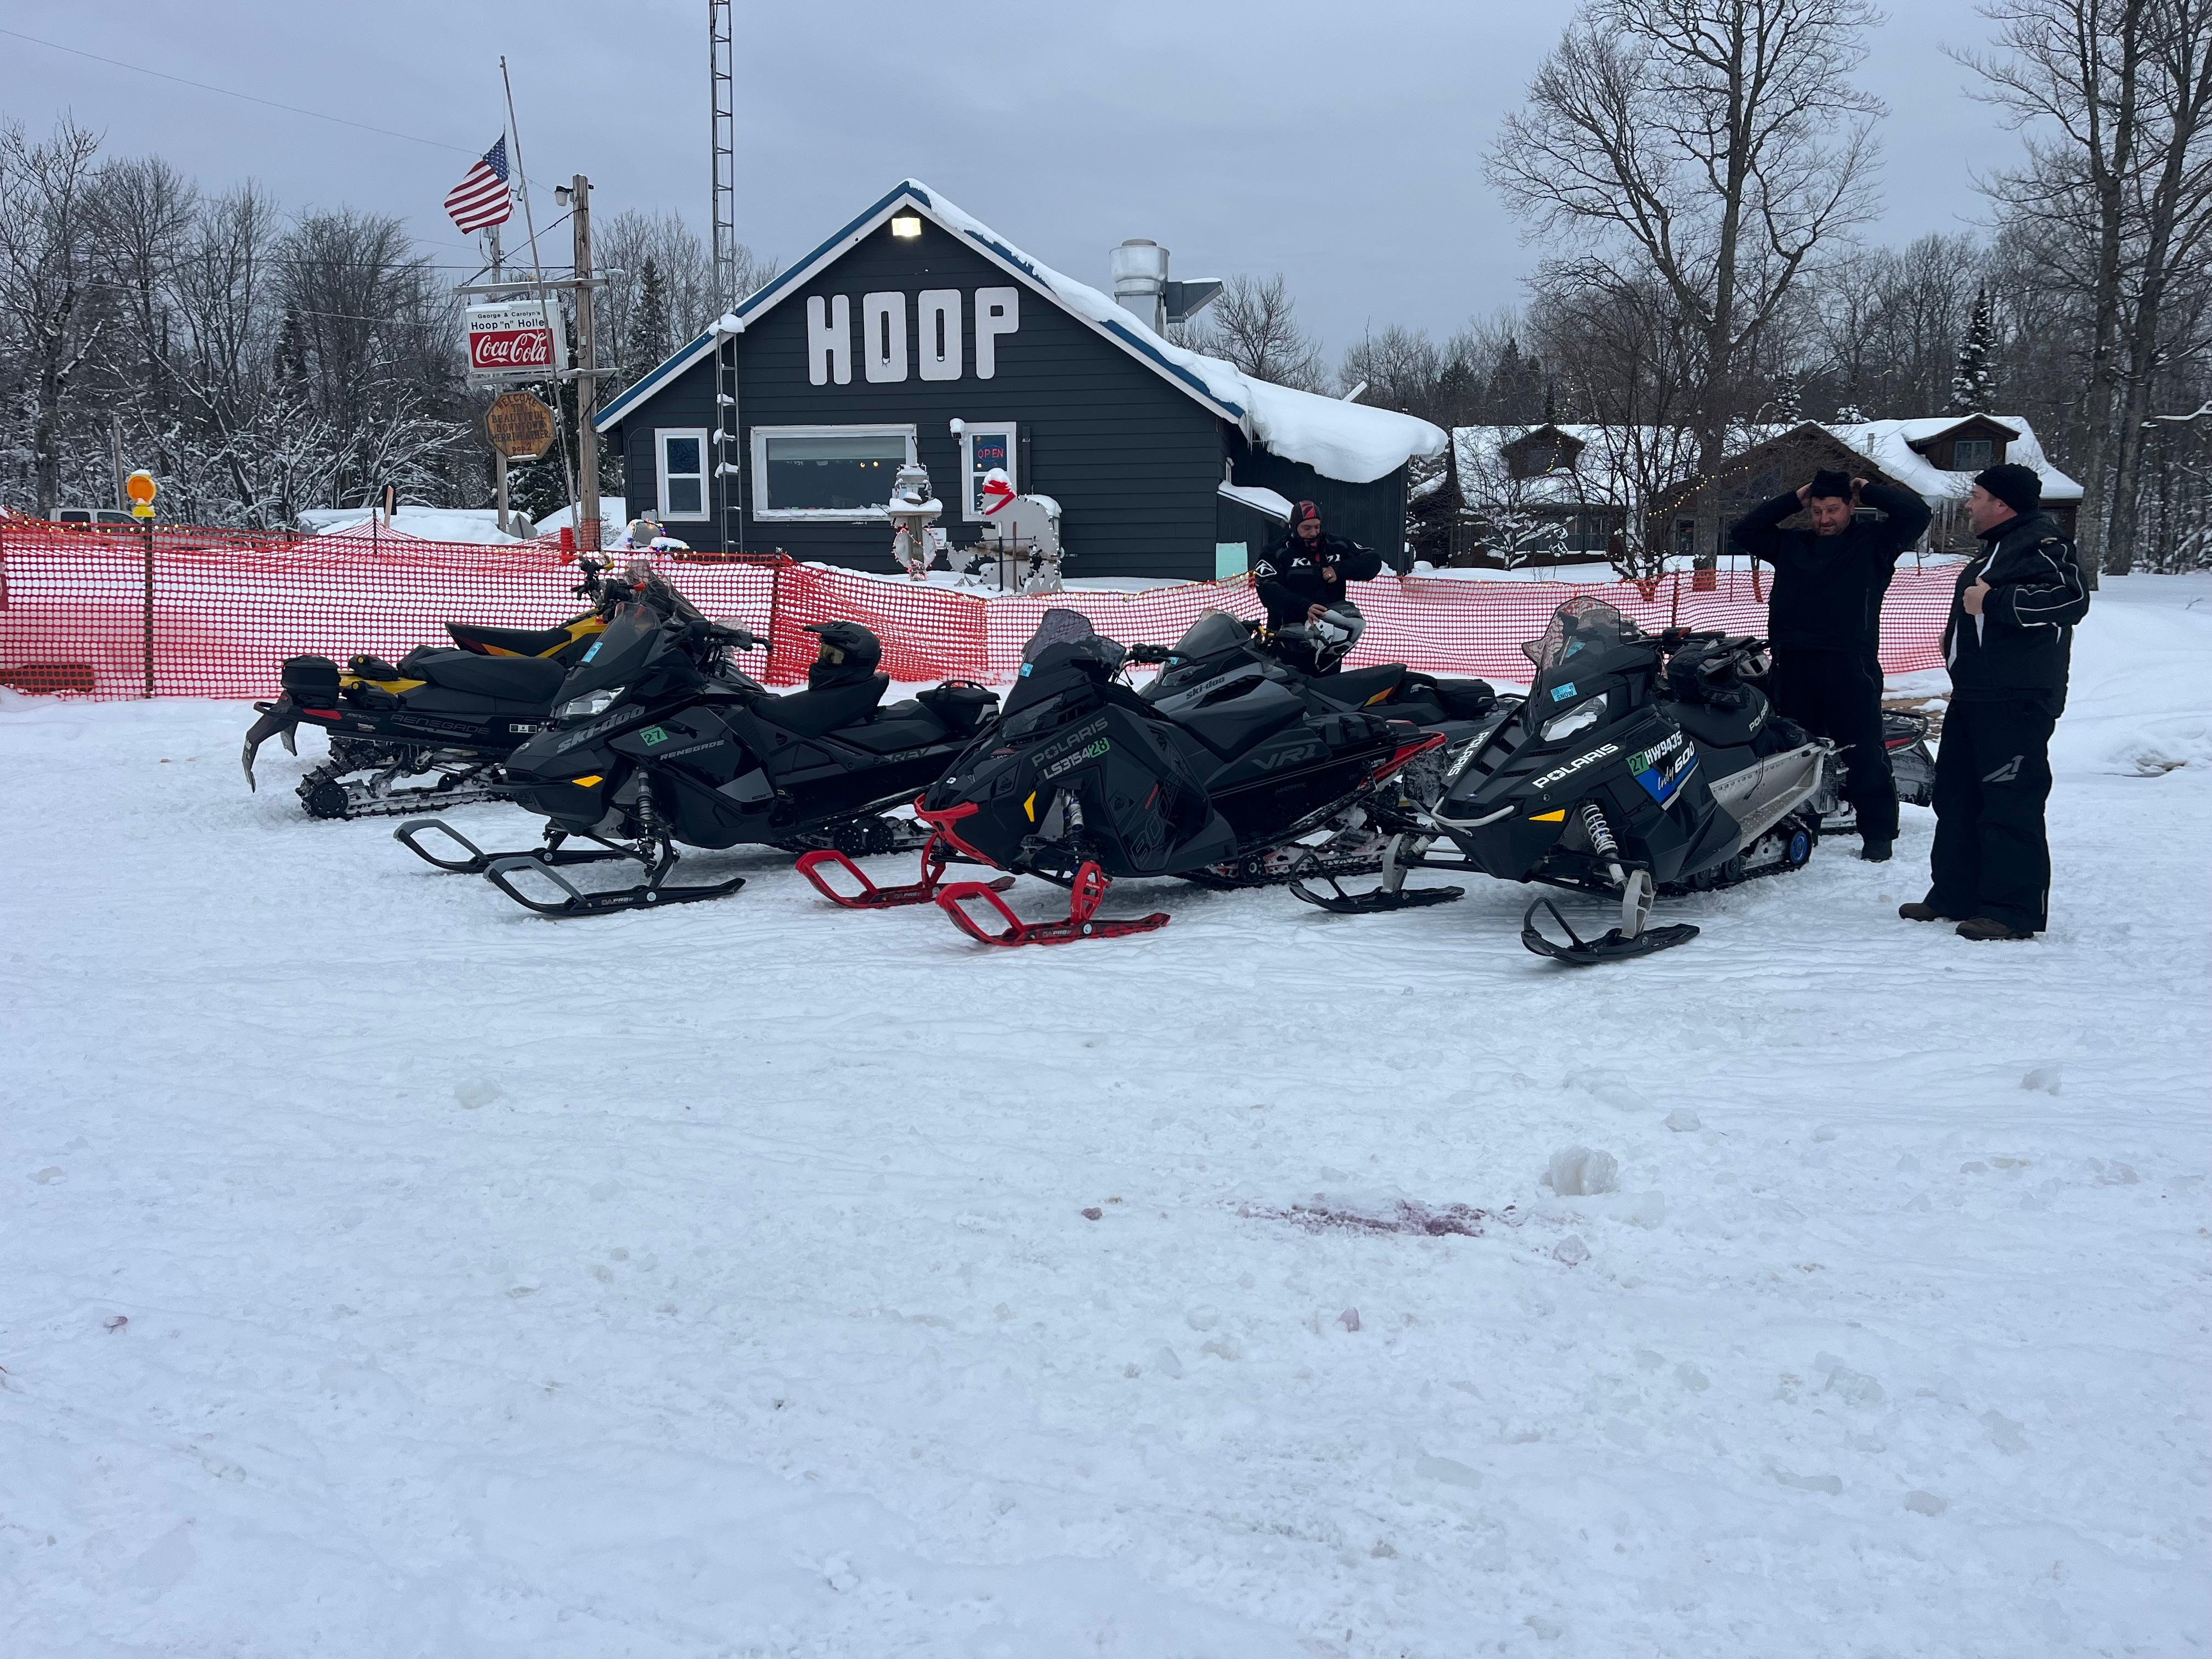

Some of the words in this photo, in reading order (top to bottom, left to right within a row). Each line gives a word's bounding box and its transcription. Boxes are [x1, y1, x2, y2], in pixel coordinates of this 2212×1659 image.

[471, 321, 498, 330] Hoop
[518, 319, 545, 328] Holle
[806, 286, 1019, 386] HOOP
[476, 332, 547, 364] Coca-Cola
[496, 394, 538, 409] WELCOME
[492, 410, 546, 424] BEAUTIFUL
[496, 420, 545, 432] DOWNTOWN
[978, 448, 1004, 459] OPEN
[1556, 690, 1573, 700] SNOW
[390, 714, 492, 735] RENEGADE
[644, 730, 661, 743] 27
[1031, 716, 1109, 768] POLARIS
[659, 739, 725, 761] RENEGADE
[890, 747, 930, 762] REV
[1043, 747, 1091, 780] LS3154
[1089, 738, 1108, 755] 28
[1447, 731, 1490, 776] POLARIS
[1629, 755, 1644, 773] 27
[1644, 730, 1683, 765] HW9435
[1675, 741, 1695, 773] 600
[1532, 743, 1619, 789] POLARIS
